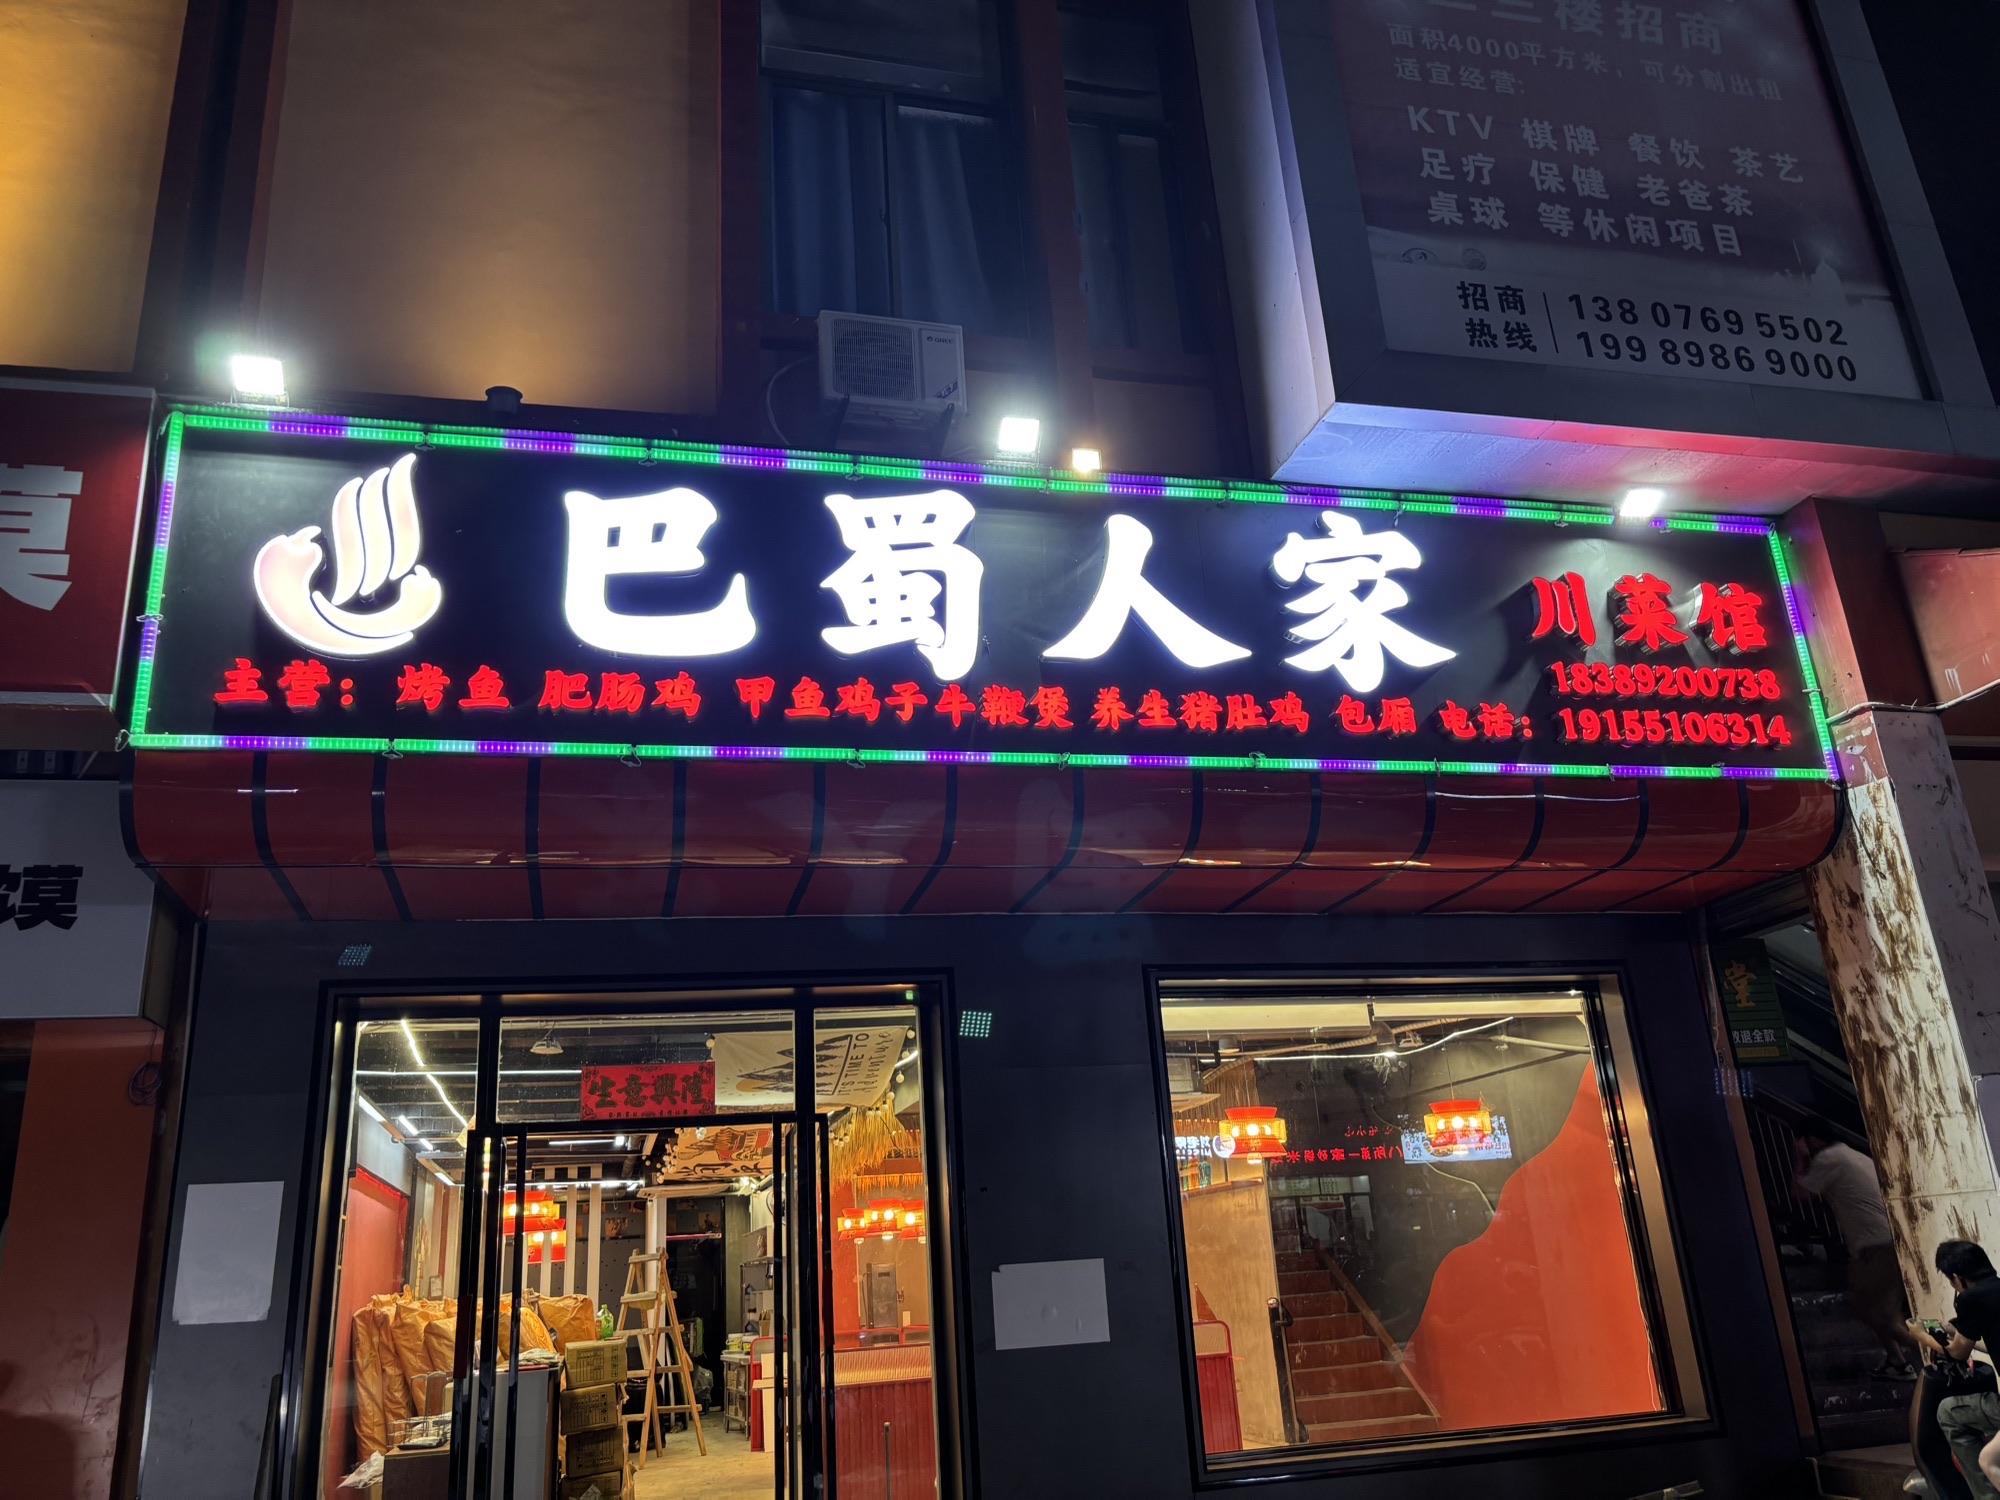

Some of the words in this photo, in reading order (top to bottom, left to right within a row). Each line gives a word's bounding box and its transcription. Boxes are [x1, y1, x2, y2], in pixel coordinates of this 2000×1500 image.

[1407, 105, 1493, 140] KTV
[1521, 118, 1600, 156] 棋牌
[1627, 132, 1705, 171] 餐饮
[1729, 146, 1804, 183] 茶艺
[1420, 147, 1495, 185] 足疗
[1529, 160, 1610, 200] 保健
[1637, 173, 1753, 216] 老爸茶
[1428, 191, 1509, 230] 桌球
[1537, 202, 1742, 256] 等休闲项目
[1456, 280, 1526, 315] 招商
[1568, 294, 1639, 325] 138
[1651, 301, 1744, 335] 0769
[1754, 312, 1848, 346] 5502
[1465, 317, 1537, 353] 热线
[1576, 331, 1646, 363] 199
[1658, 338, 1754, 373] 8986
[1765, 348, 1857, 382] 9000
[563, 486, 1457, 693] 巴蜀人家
[1531, 571, 1767, 652] 川菜馆
[396, 663, 510, 711] 烤鱼
[538, 669, 702, 717] 肥肠鸡
[735, 675, 1074, 728] 甲鱼鸡子牛鞭煲
[1091, 687, 1309, 733] 养生猪肚鸡
[1335, 694, 1417, 736] 包厢
[1551, 661, 1781, 700] 18389200738
[1559, 708, 1792, 746] 19155106314
[844, 1053, 865, 1078] TIME
[853, 1033, 869, 1050] TO
